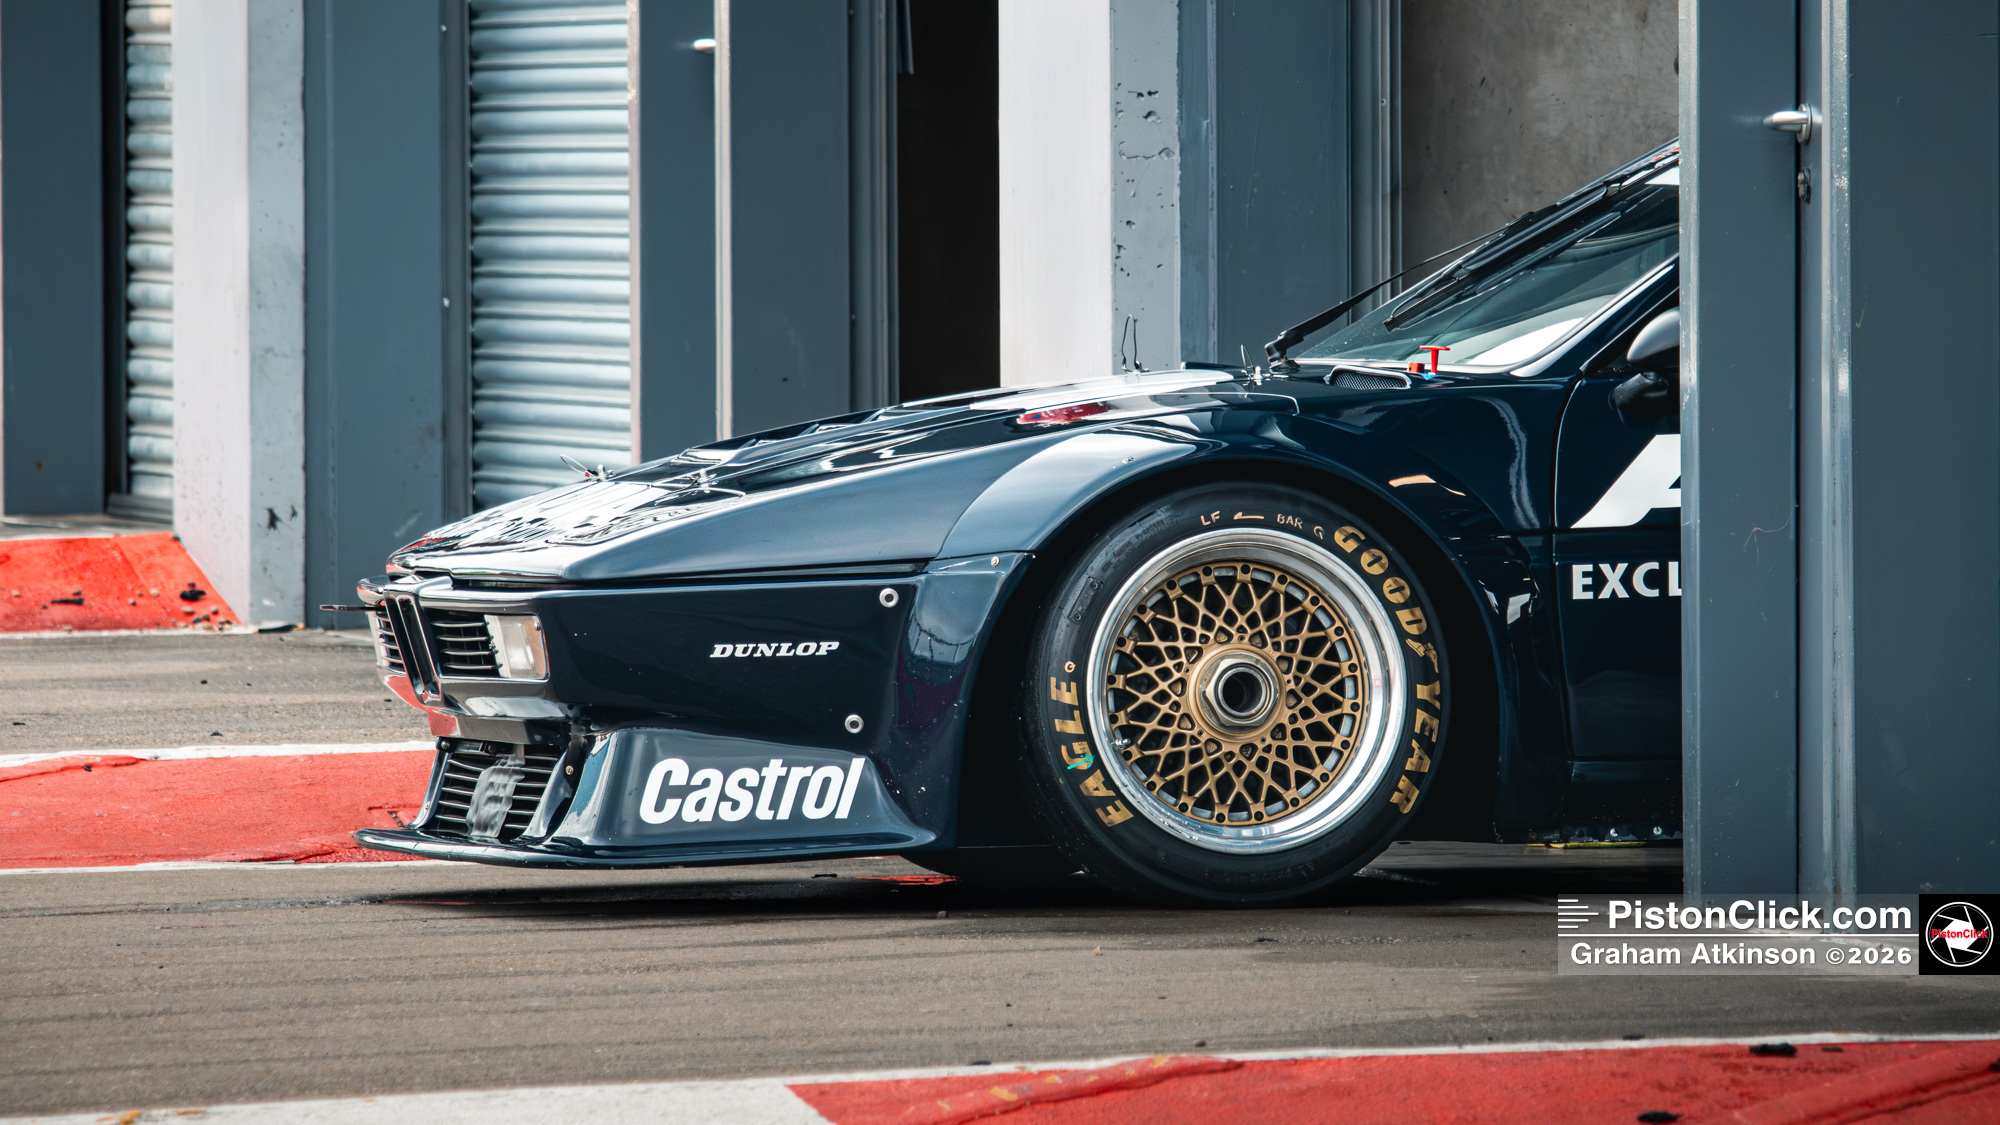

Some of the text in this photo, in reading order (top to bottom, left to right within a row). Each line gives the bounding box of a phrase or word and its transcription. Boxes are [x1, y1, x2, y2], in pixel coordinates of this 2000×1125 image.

[1200, 510, 1220, 526] LF
[1277, 513, 1303, 529] BAR
[710, 641, 840, 658] DUNLOP
[1050, 676, 1134, 827] EAGLE
[639, 757, 866, 825] Castrol
